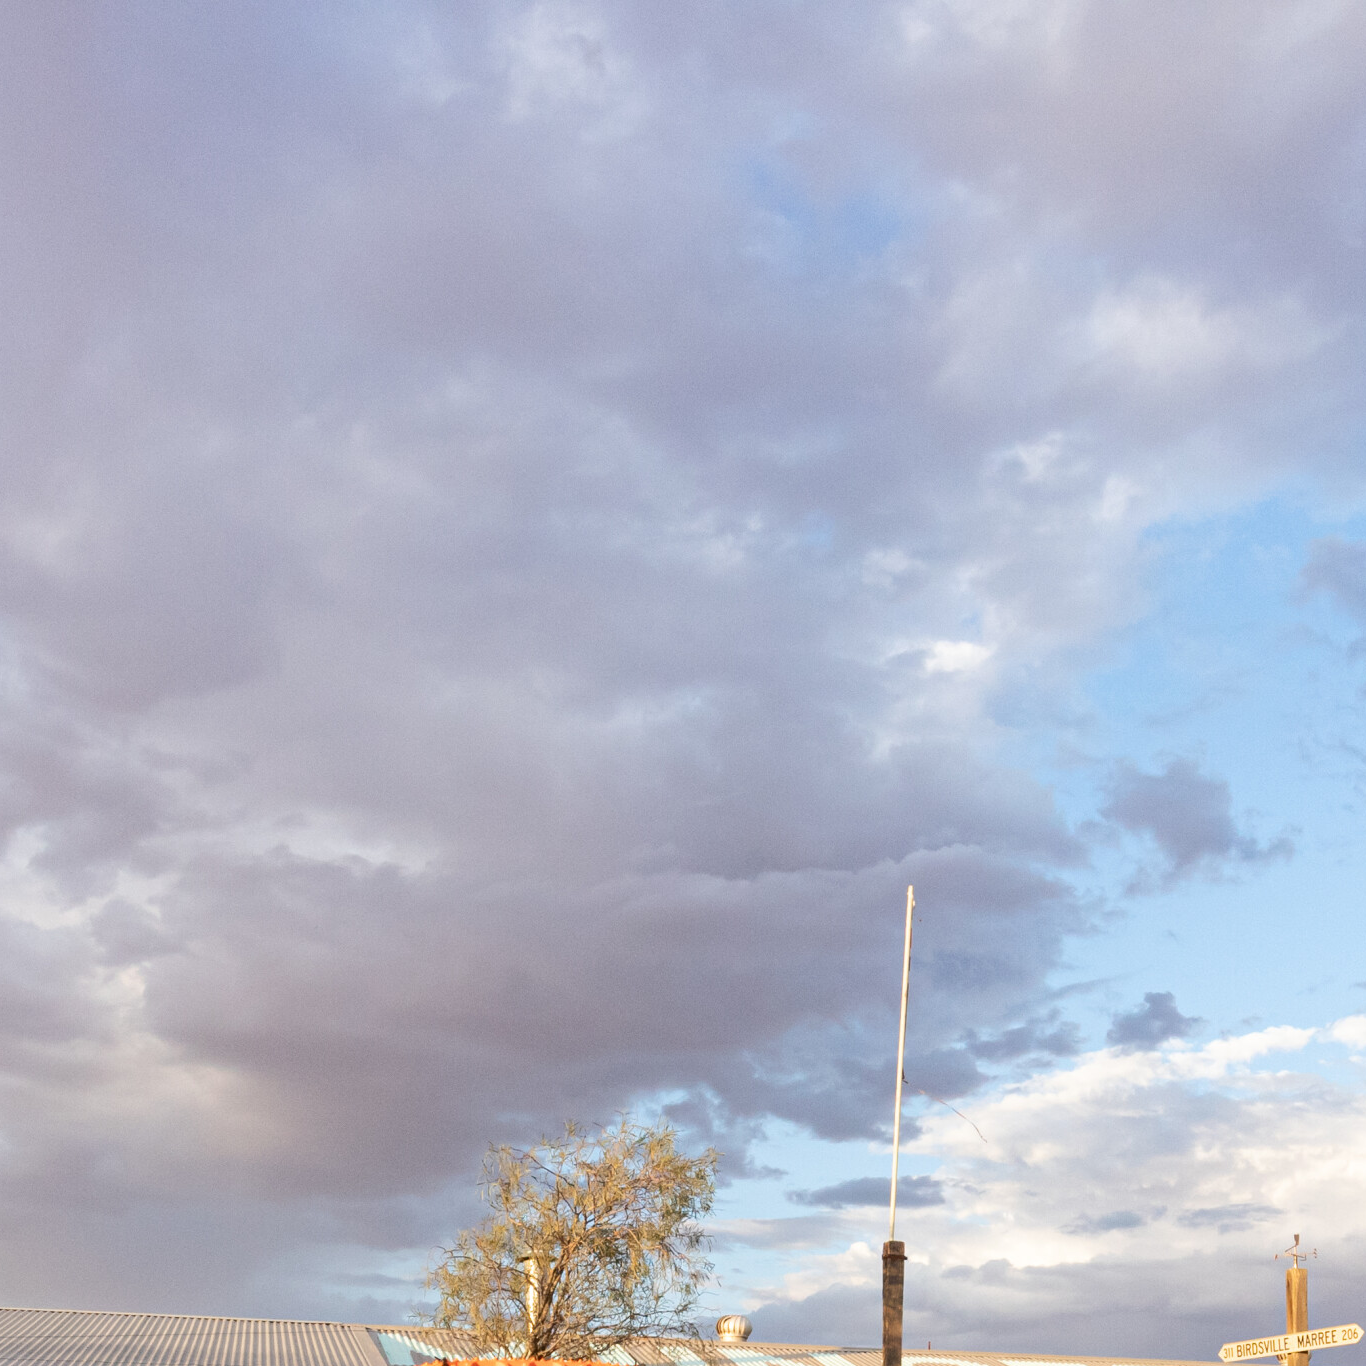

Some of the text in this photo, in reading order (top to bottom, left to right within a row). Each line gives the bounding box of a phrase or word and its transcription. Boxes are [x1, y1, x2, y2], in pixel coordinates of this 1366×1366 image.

[1223, 1328, 1359, 1359] 311 BIRDSVILLE MARREE 206
